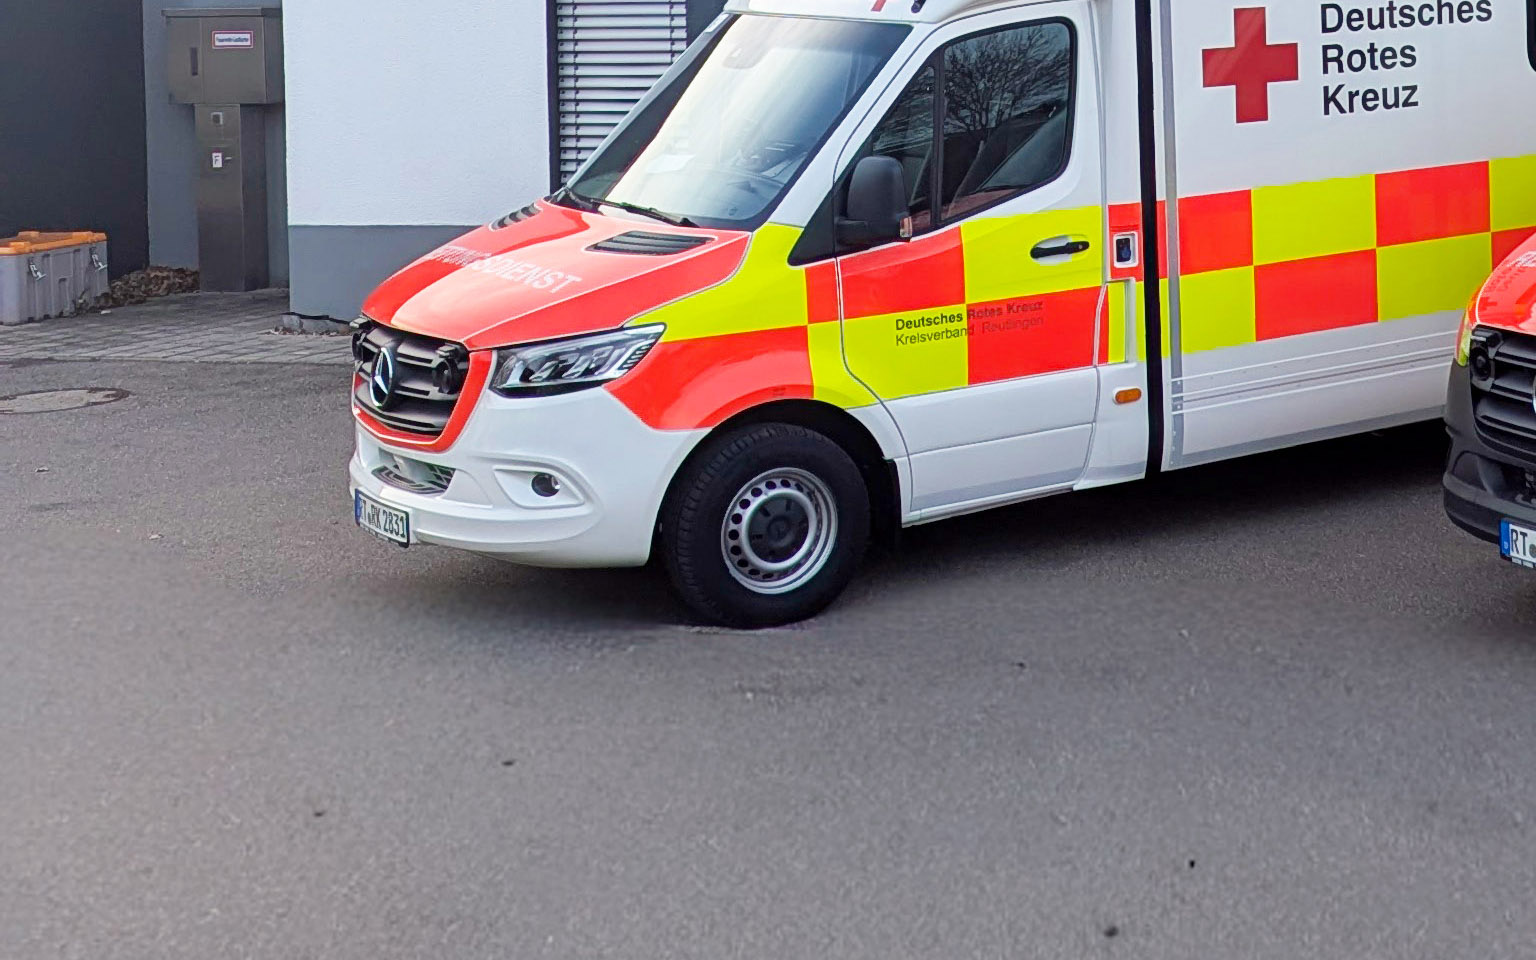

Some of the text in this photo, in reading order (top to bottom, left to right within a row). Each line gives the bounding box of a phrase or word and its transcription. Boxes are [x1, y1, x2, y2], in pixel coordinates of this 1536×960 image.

[1322, 42, 1417, 75] Rotes
[1323, 84, 1419, 116] Kreuz
[895, 312, 963, 331] Deutsches
[383, 509, 405, 538] 2831
[1510, 528, 1528, 556] RT
